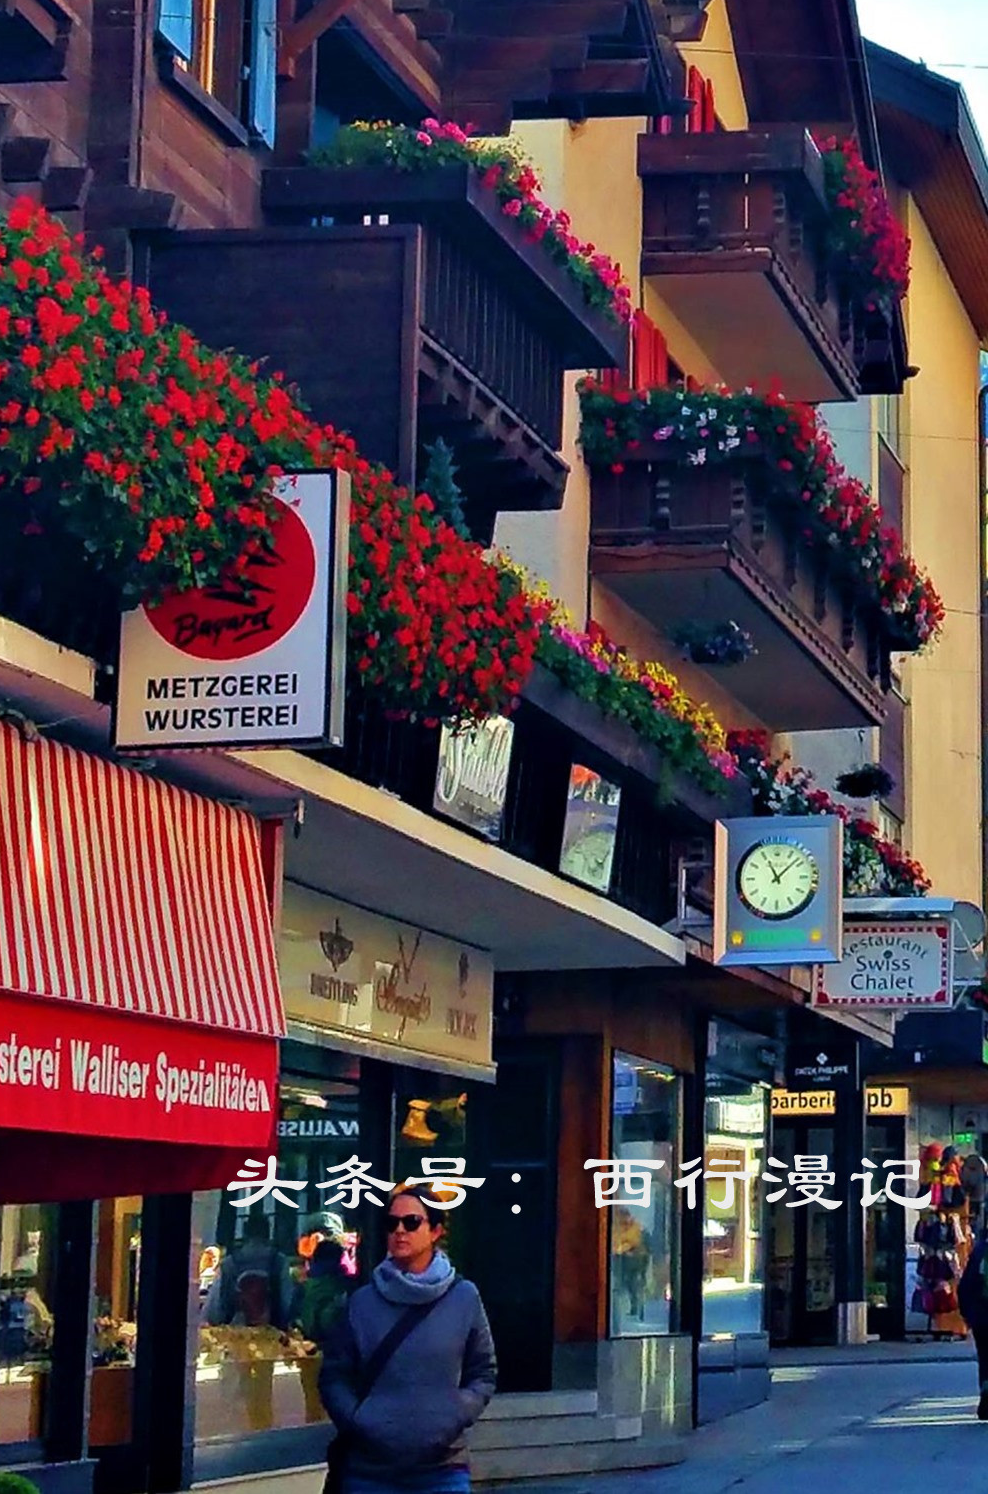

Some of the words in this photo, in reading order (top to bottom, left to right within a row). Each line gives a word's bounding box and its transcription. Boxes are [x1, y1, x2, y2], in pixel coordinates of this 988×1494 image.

[173, 605, 275, 647] Bayard
[147, 673, 298, 700] METZGEREI
[145, 705, 298, 731] WURSTEREI
[856, 951, 911, 972] Swiss
[850, 973, 914, 991] Chalet
[70, 1039, 150, 1099] Walliser
[155, 1051, 271, 1113] Spezialitäten
[867, 1089, 893, 1113] pb
